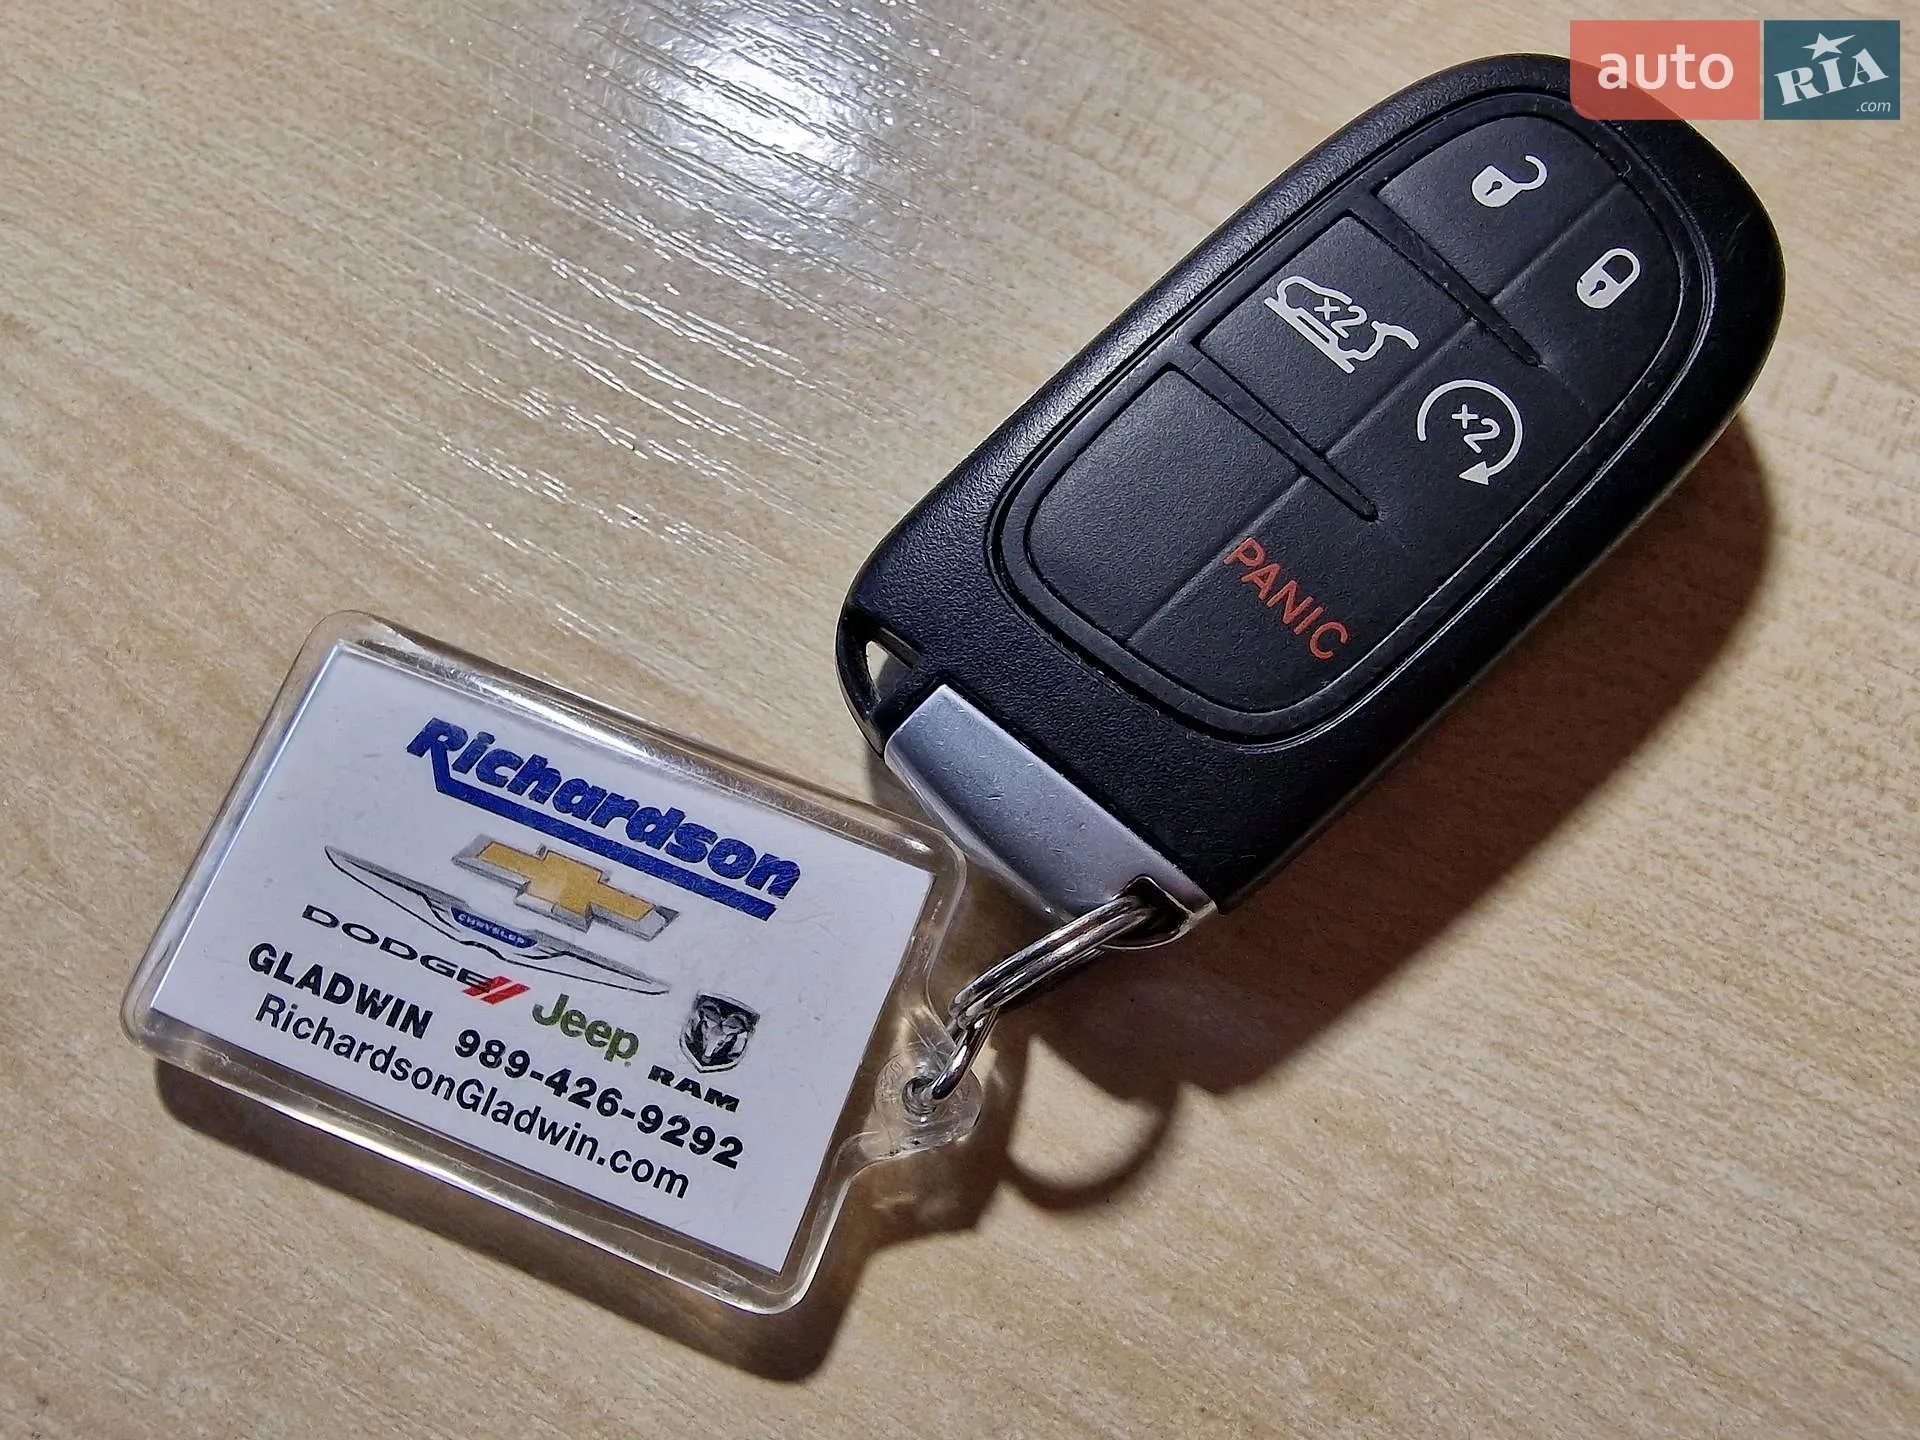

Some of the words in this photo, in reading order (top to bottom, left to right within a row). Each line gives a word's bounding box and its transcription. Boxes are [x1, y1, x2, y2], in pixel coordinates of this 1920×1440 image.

[1225, 537, 1349, 661] PANIC
[406, 717, 802, 901] Richardson
[302, 905, 492, 989] DODGE
[249, 943, 433, 1039] GLADWIN
[455, 1030, 744, 1169] 989-426-9292
[532, 993, 640, 1063] Jeep
[649, 1065, 740, 1112] RAM
[256, 994, 690, 1199] RichardsonGladwin.com
